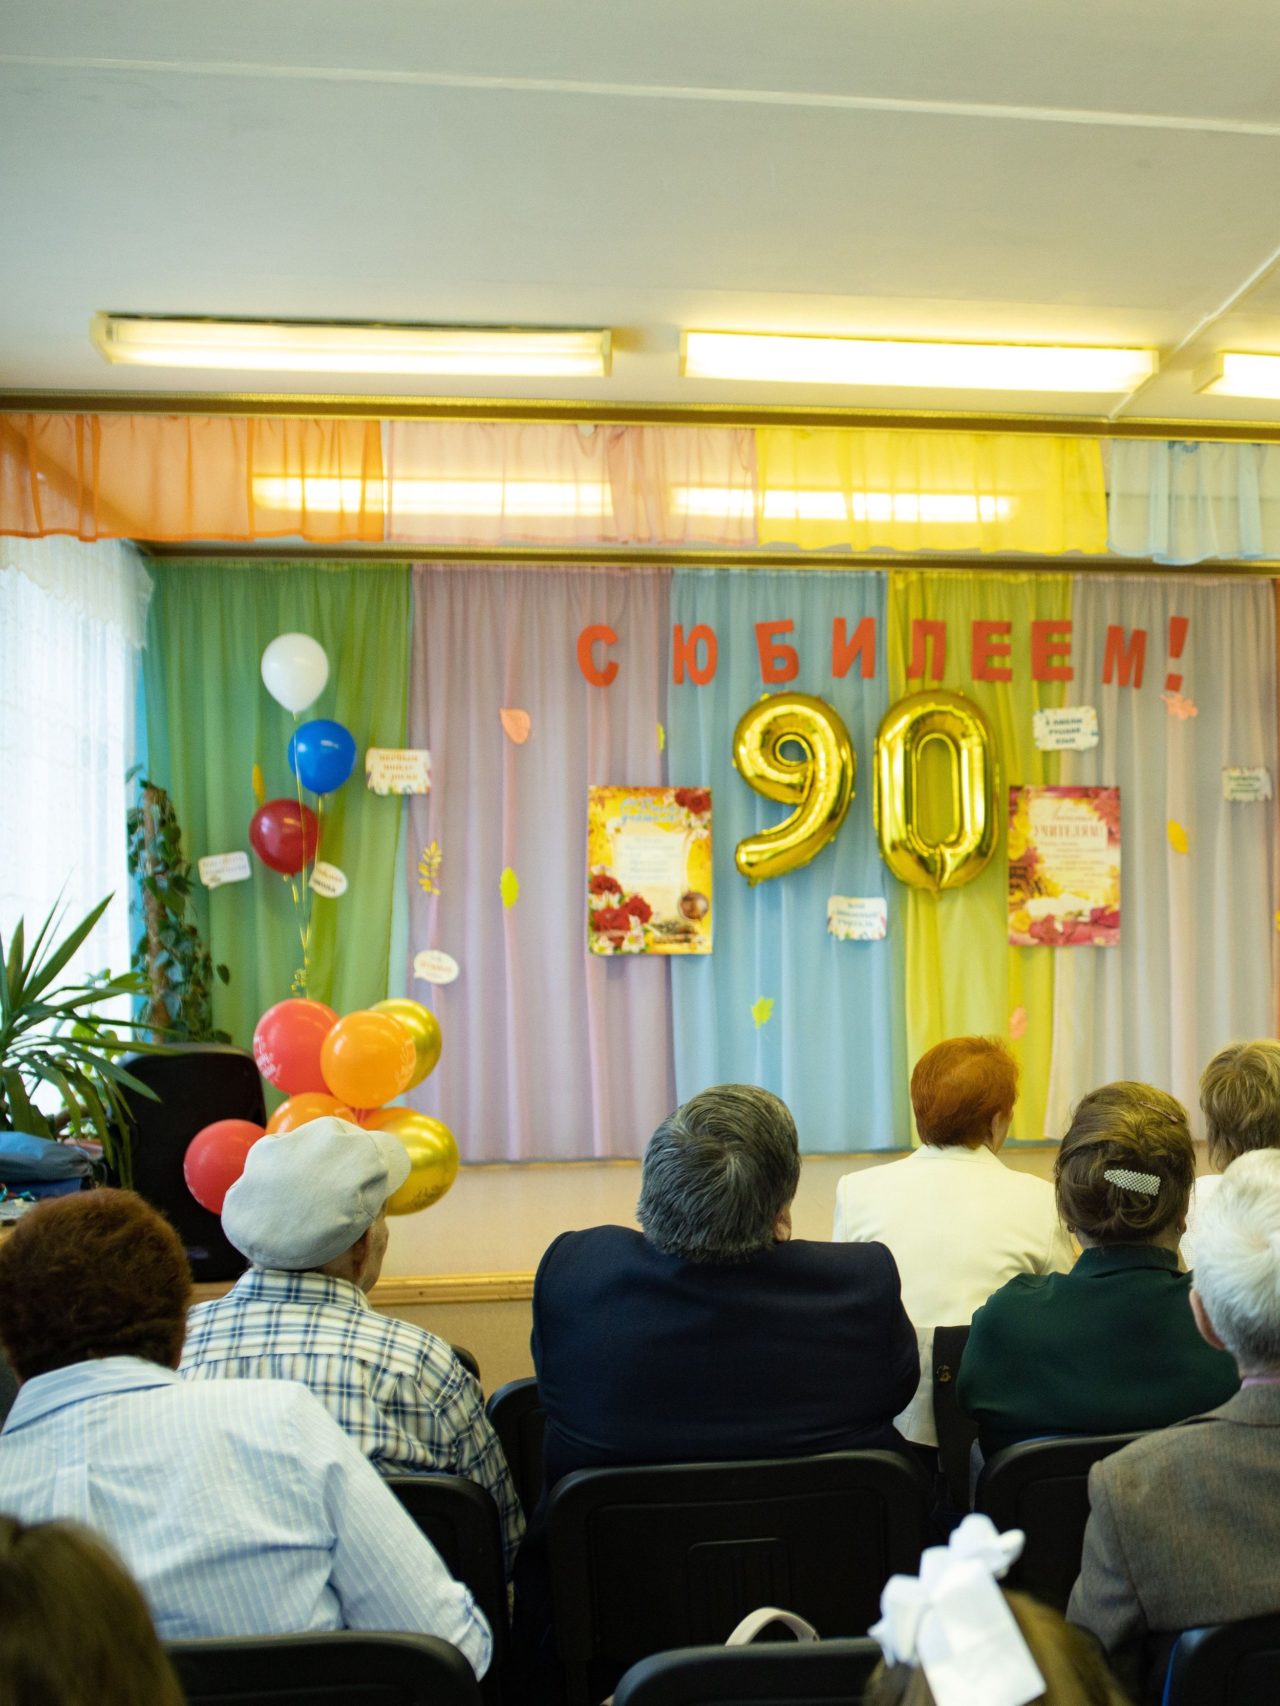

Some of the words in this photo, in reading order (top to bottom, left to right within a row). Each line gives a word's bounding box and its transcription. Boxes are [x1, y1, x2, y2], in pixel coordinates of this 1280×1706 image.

[576, 623, 619, 688] С
[673, 616, 1189, 693] ЮБИЛЕЕМ!
[733, 689, 999, 891] 90
